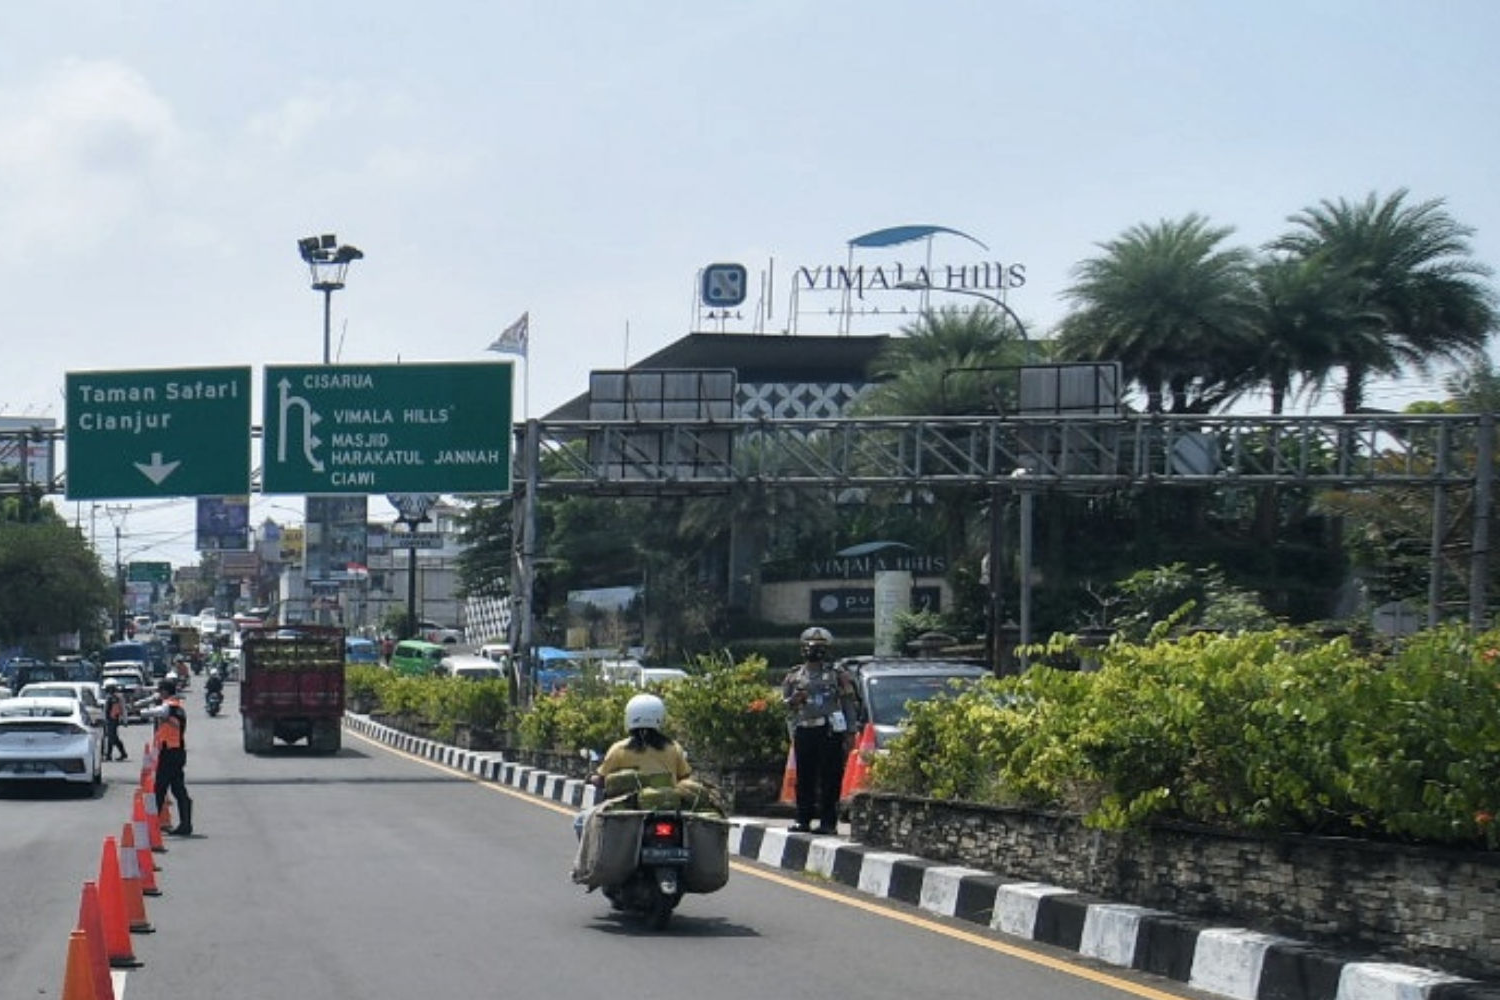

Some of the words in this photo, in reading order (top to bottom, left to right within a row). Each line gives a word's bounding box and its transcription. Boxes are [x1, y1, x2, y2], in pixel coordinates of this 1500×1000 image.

[303, 374, 374, 389] CISARUA
[78, 385, 156, 403] Taman
[166, 380, 238, 400] Safari
[78, 411, 172, 434] Cianjur
[333, 410, 393, 424] VIMALA
[404, 409, 449, 423] HILLS
[331, 433, 389, 448] MASJID
[331, 450, 424, 466] HARAKATUL
[434, 450, 499, 465] JANNAH
[331, 471, 375, 486] CIAWI
